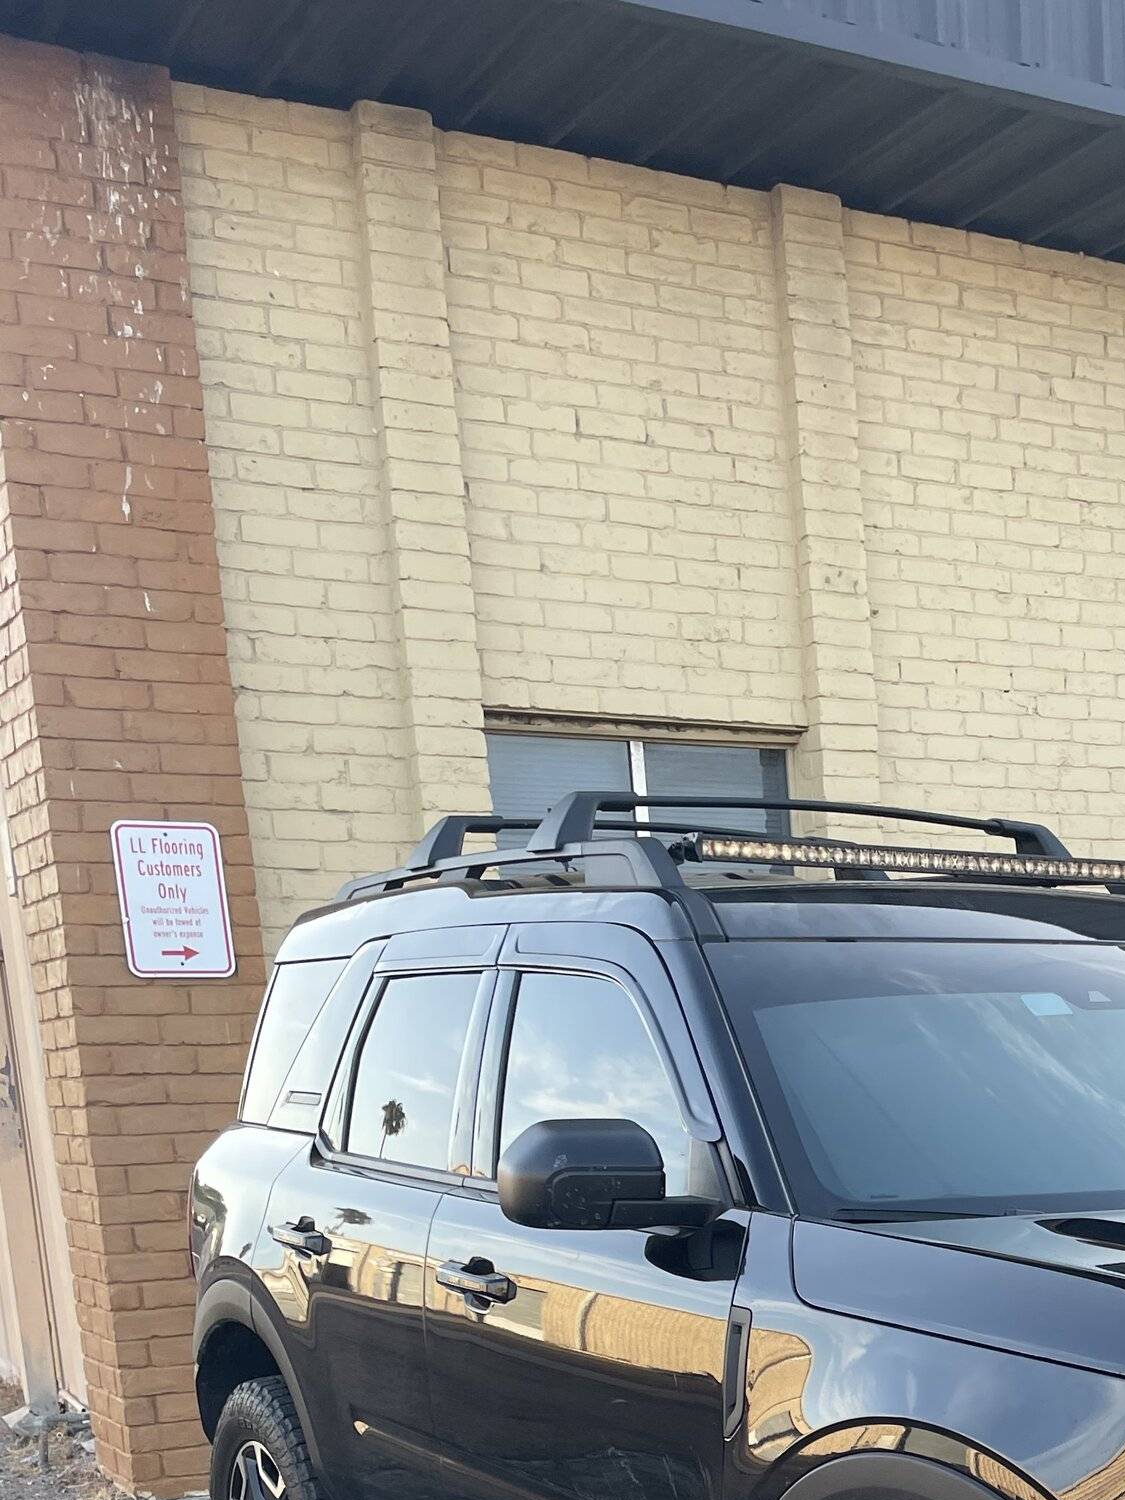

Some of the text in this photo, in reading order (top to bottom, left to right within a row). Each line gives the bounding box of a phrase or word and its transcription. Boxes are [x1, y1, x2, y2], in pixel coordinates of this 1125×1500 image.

[130, 837, 204, 860] LL Flooring
[137, 859, 202, 878] Customers
[158, 883, 187, 903] Only
